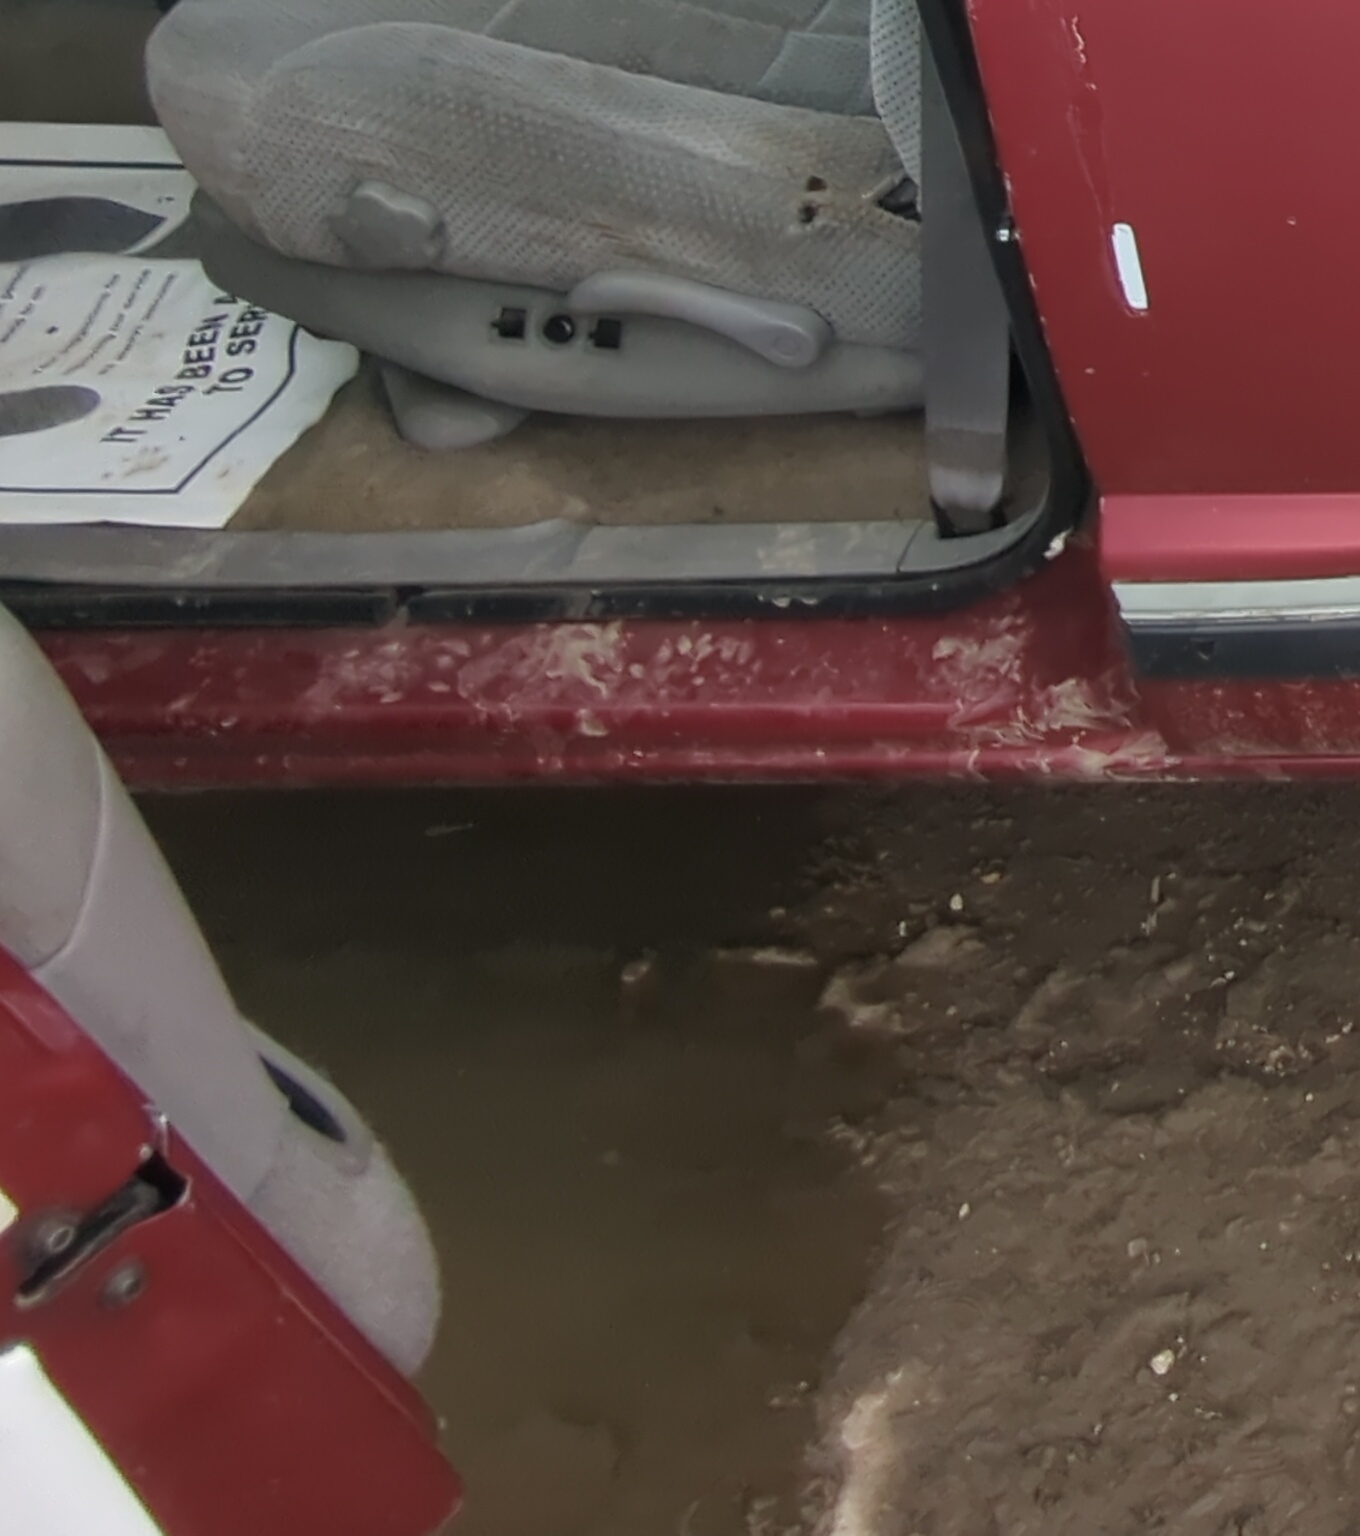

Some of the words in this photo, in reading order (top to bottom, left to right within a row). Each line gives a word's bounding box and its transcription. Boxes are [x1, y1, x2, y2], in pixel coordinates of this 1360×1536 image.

[226, 304, 270, 357] SER
[99, 426, 148, 443] IT
[128, 384, 196, 421] HAS
[174, 313, 229, 380] BEEN
[201, 367, 254, 395] TO
